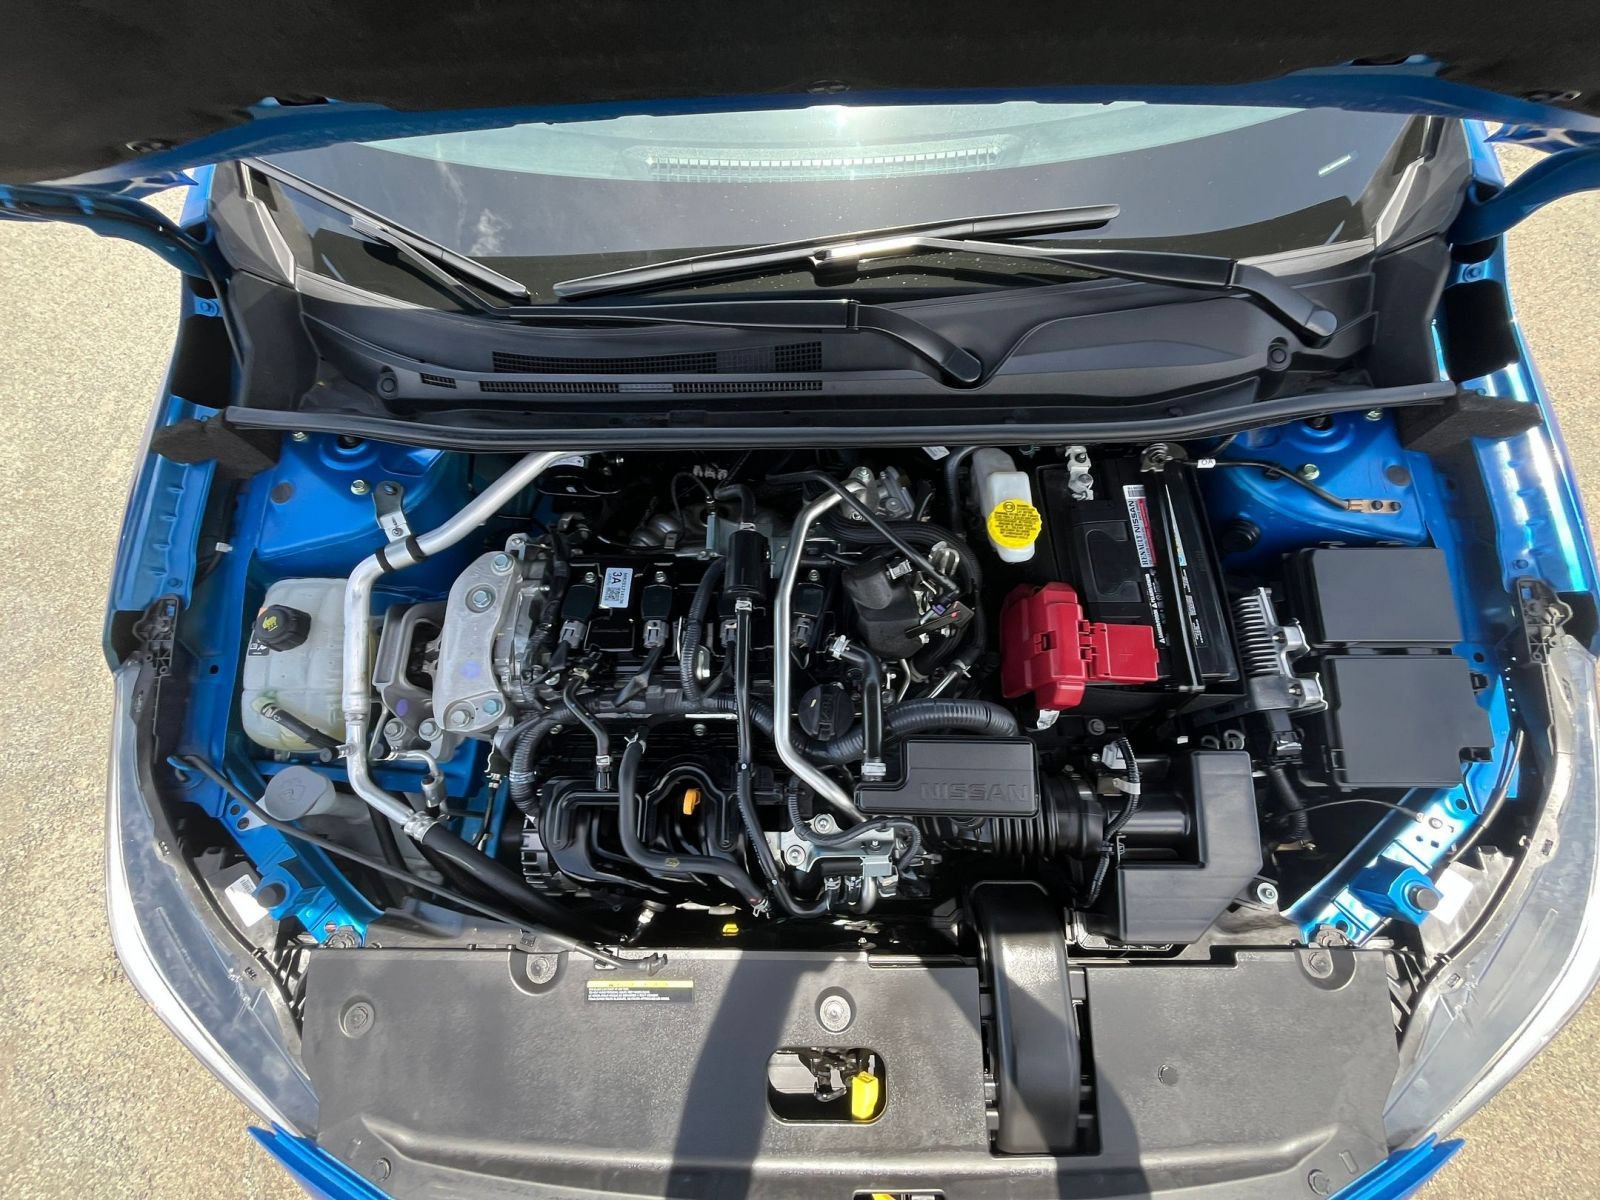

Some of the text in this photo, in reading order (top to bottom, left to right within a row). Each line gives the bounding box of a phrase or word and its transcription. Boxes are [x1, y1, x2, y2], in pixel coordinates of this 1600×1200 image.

[1128, 500, 1141, 533] NISSAN
[1136, 534, 1149, 566] RENAULT
[611, 571, 623, 585] 3A
[920, 783, 1031, 801] NISSAN
